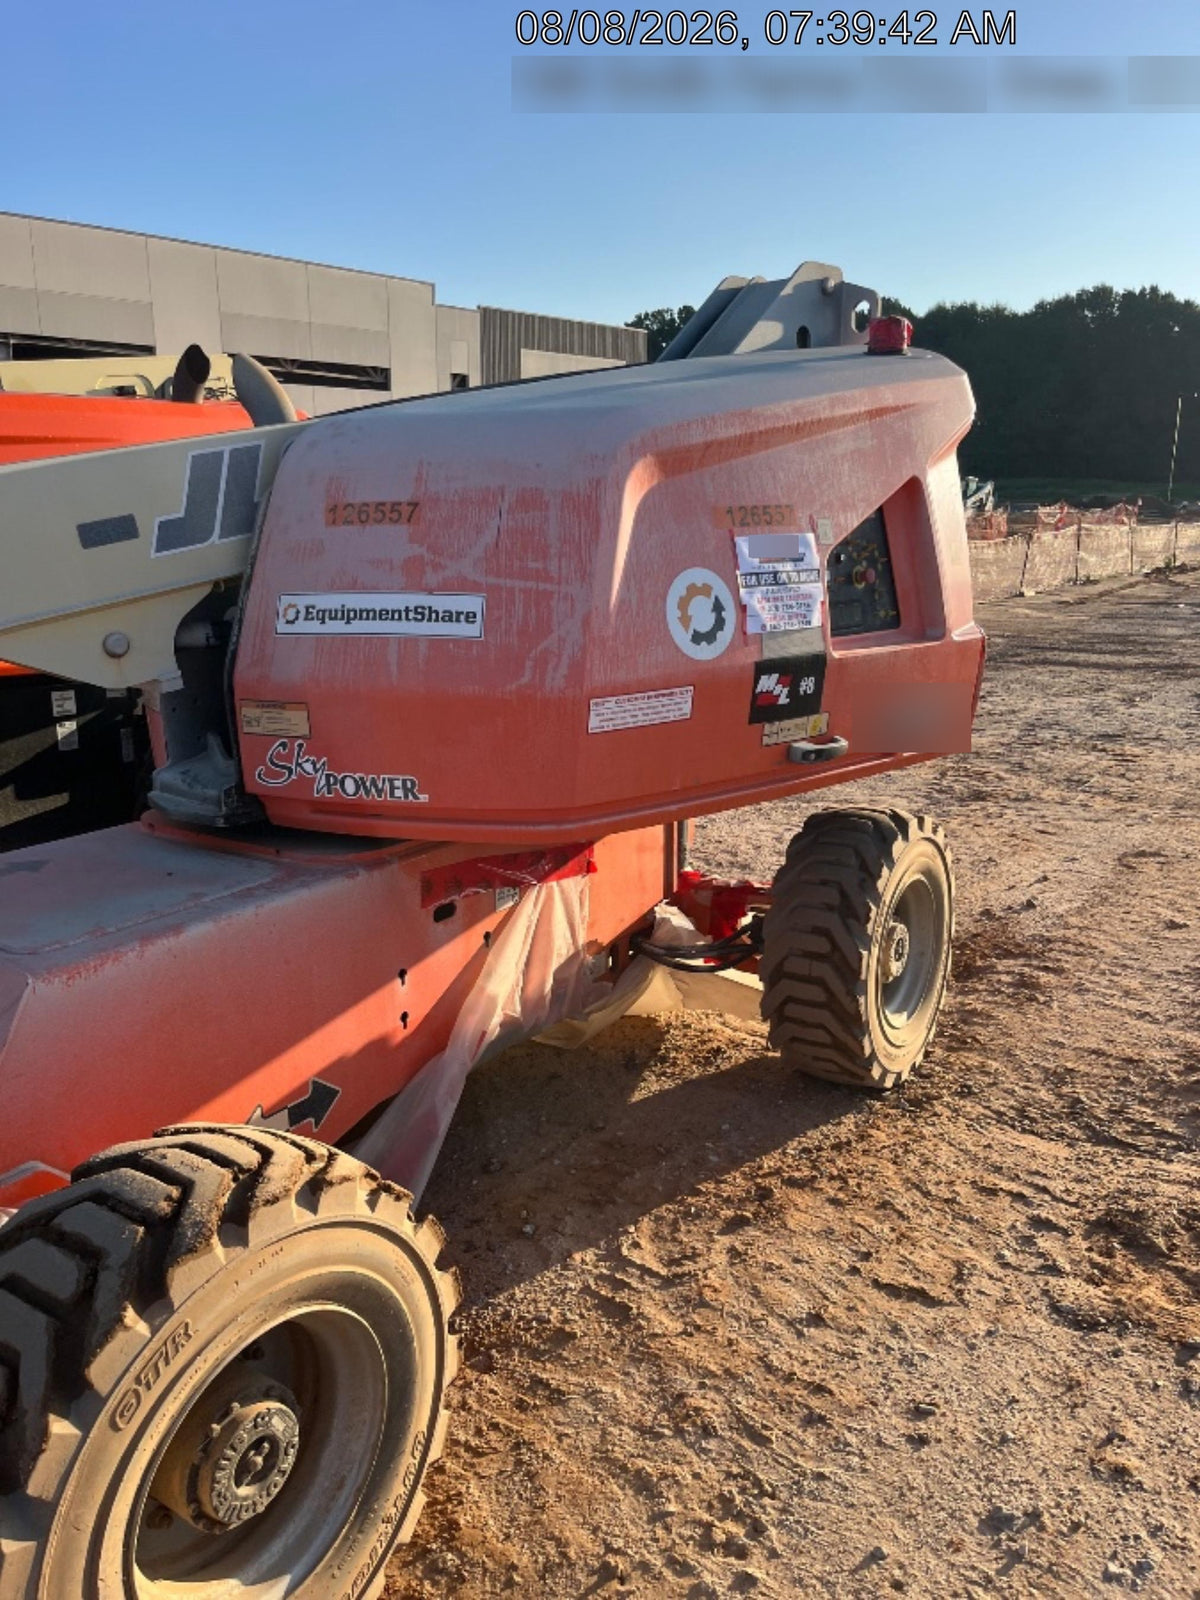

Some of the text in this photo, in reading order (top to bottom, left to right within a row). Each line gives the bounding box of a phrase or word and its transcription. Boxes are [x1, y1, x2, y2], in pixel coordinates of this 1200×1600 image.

[151, 440, 265, 559] JL
[328, 501, 420, 527] 126557
[726, 504, 794, 527] 126557
[303, 604, 478, 625] EquipmentShare
[255, 738, 329, 797] Sky
[322, 772, 421, 802] POWER
